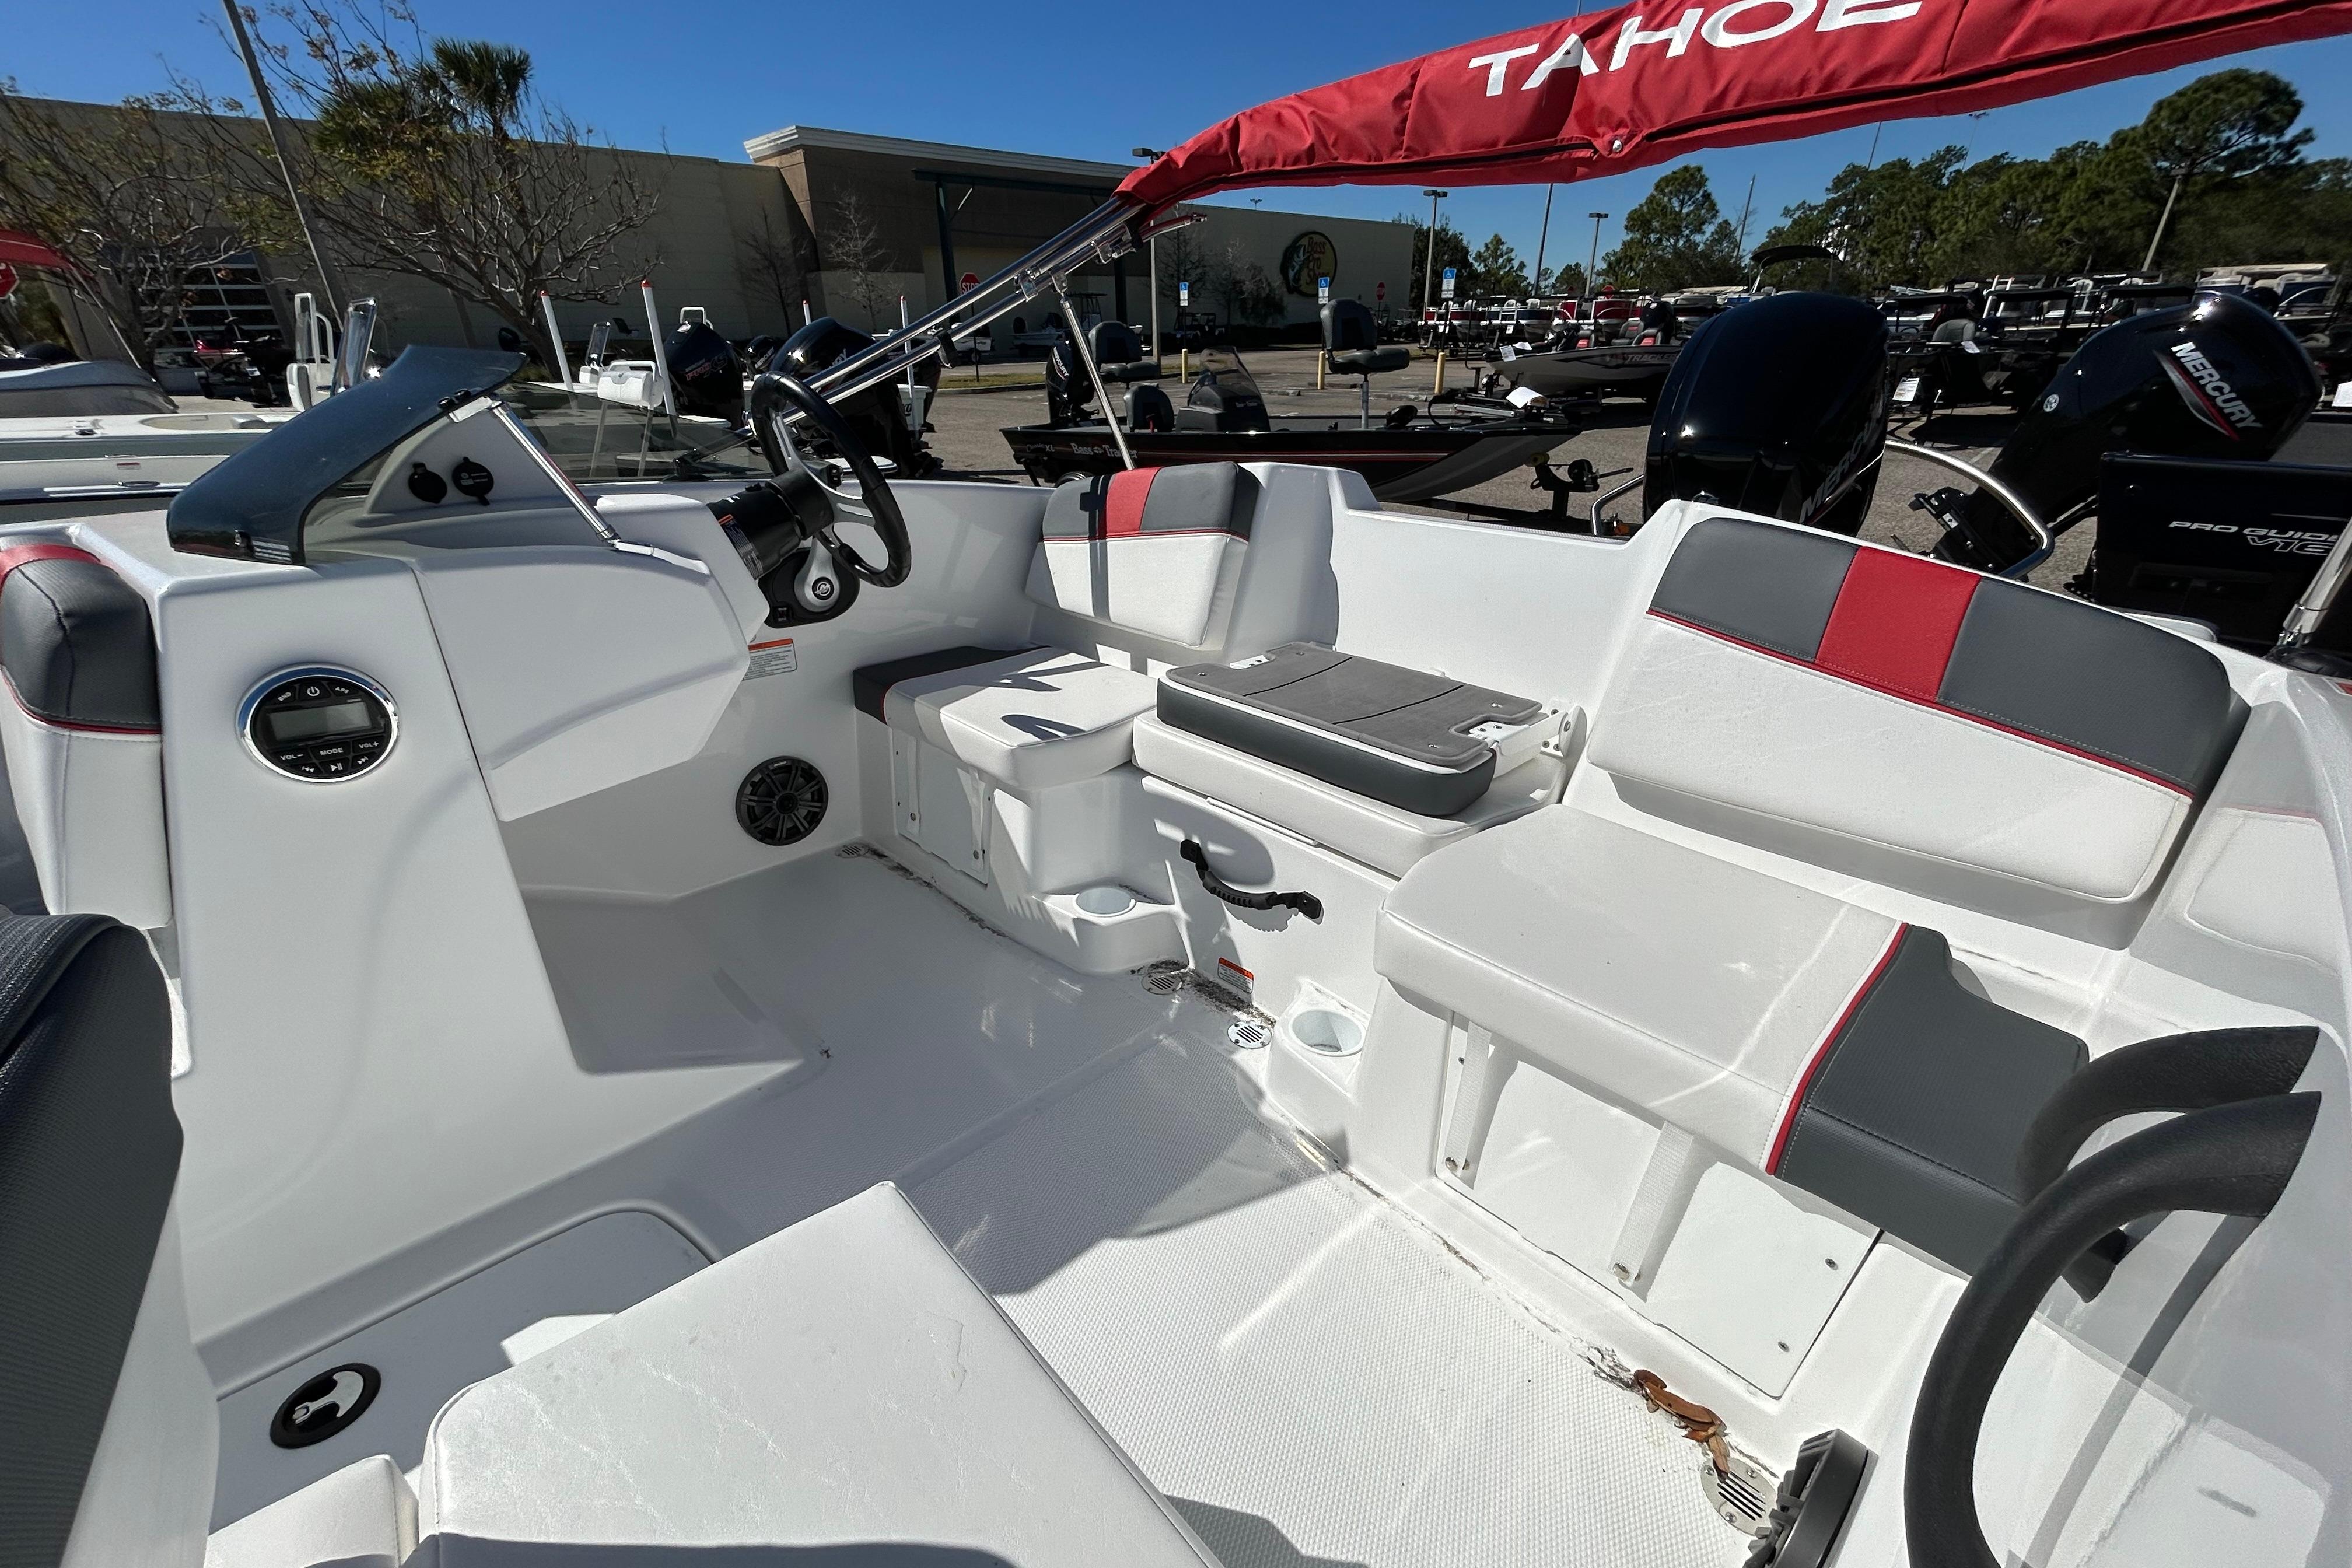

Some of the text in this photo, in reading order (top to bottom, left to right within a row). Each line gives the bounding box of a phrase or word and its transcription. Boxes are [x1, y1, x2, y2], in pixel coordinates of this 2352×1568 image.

[1468, 0, 1923, 97] TAHOE
[1307, 237, 1326, 255] Bass
[1307, 254, 1321, 270] Pro
[2171, 342, 2264, 428] MERCURY
[1045, 444, 1055, 452] XL
[1070, 442, 1138, 459] Bass Traer
[2168, 520, 2239, 533] PRO
[335, 686, 349, 695] APS
[320, 747, 344, 756] MODE
